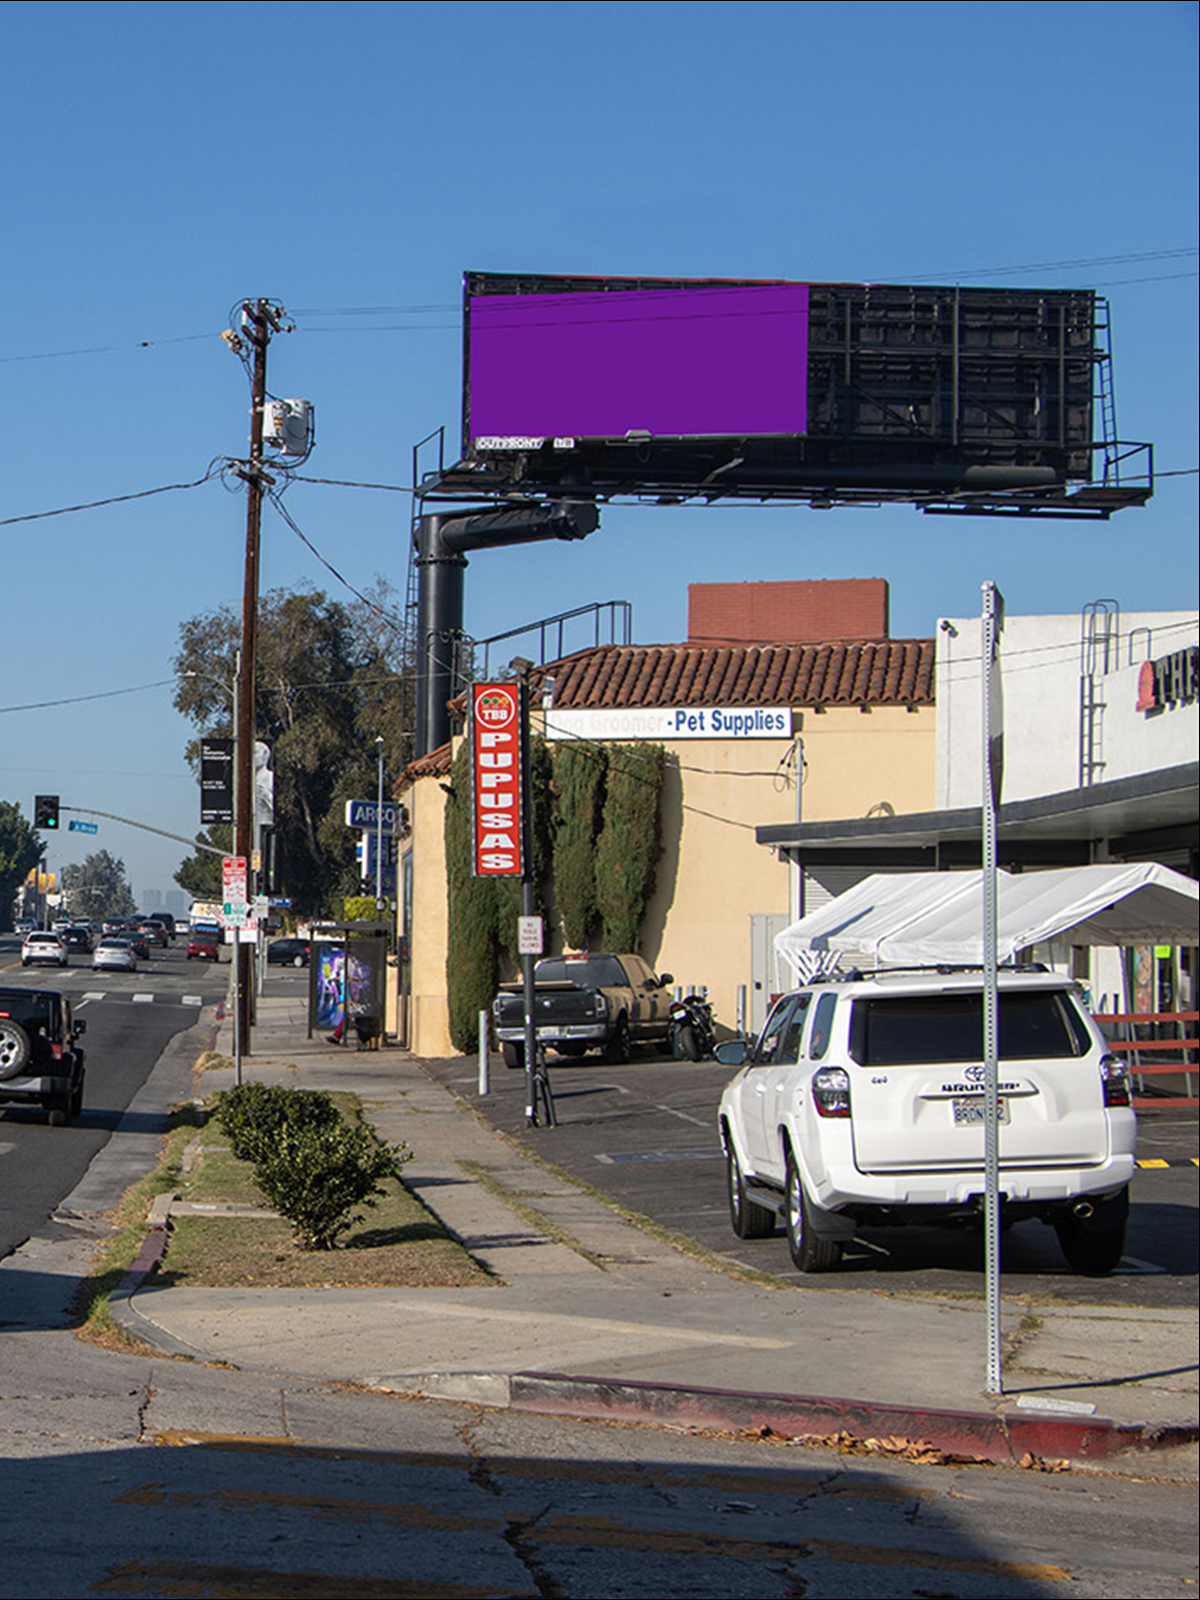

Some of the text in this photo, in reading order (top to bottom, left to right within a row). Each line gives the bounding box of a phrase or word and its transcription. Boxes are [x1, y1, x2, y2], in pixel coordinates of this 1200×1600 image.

[482, 709, 508, 720] TBB
[675, 710, 705, 731] Pet
[711, 709, 785, 736] Supplies
[479, 732, 515, 870] PUPUSAS
[942, 1082, 1016, 1092] 4RUNER
